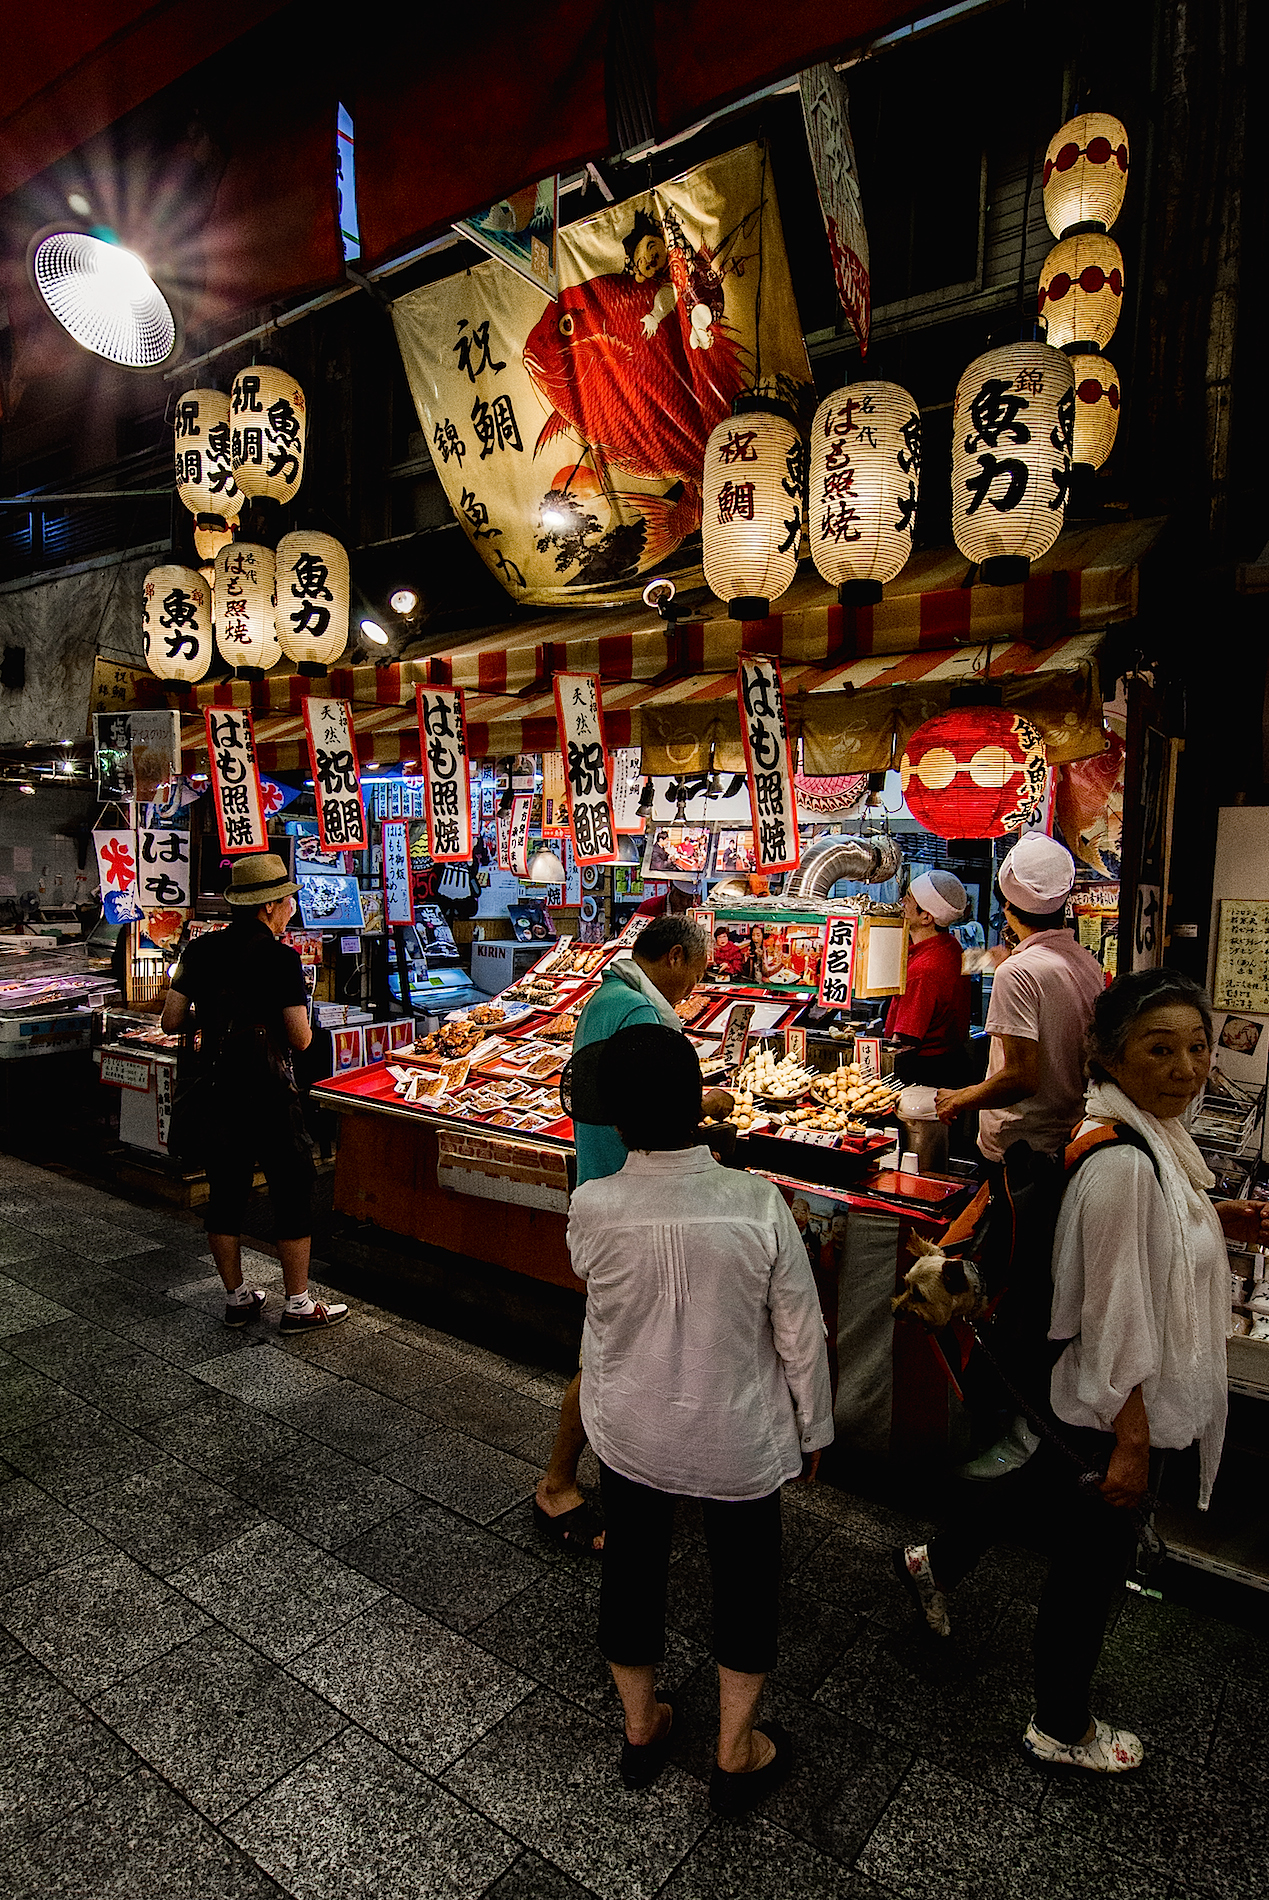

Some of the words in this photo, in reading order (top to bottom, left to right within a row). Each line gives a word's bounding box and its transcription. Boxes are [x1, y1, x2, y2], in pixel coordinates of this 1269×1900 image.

[231, 376, 263, 471] 祝鯛
[452, 318, 523, 459] 祝鯛
[855, 395, 878, 448] 名代
[1014, 368, 1044, 396] 錦
[265, 397, 301, 485] 魚力
[718, 430, 758, 525] 祝鯛
[819, 398, 861, 544] はも照焼
[964, 380, 1031, 515] 魚力
[224, 552, 252, 645] はも照焼
[243, 553, 258, 585] 名代
[289, 552, 334, 637] 魚力
[160, 588, 200, 661] 魚力
[320, 705, 342, 744] 天然
[572, 687, 591, 736] 天然
[210, 713, 254, 847] はも照焼
[316, 748, 363, 845] 祝鯛
[422, 694, 460, 854] はも照焼
[567, 741, 615, 857] 祝鯛
[743, 665, 787, 864] はも照焼
[142, 832, 189, 905] はも
[477, 944, 506, 959] KIRIN
[822, 920, 855, 1004] 京名物
